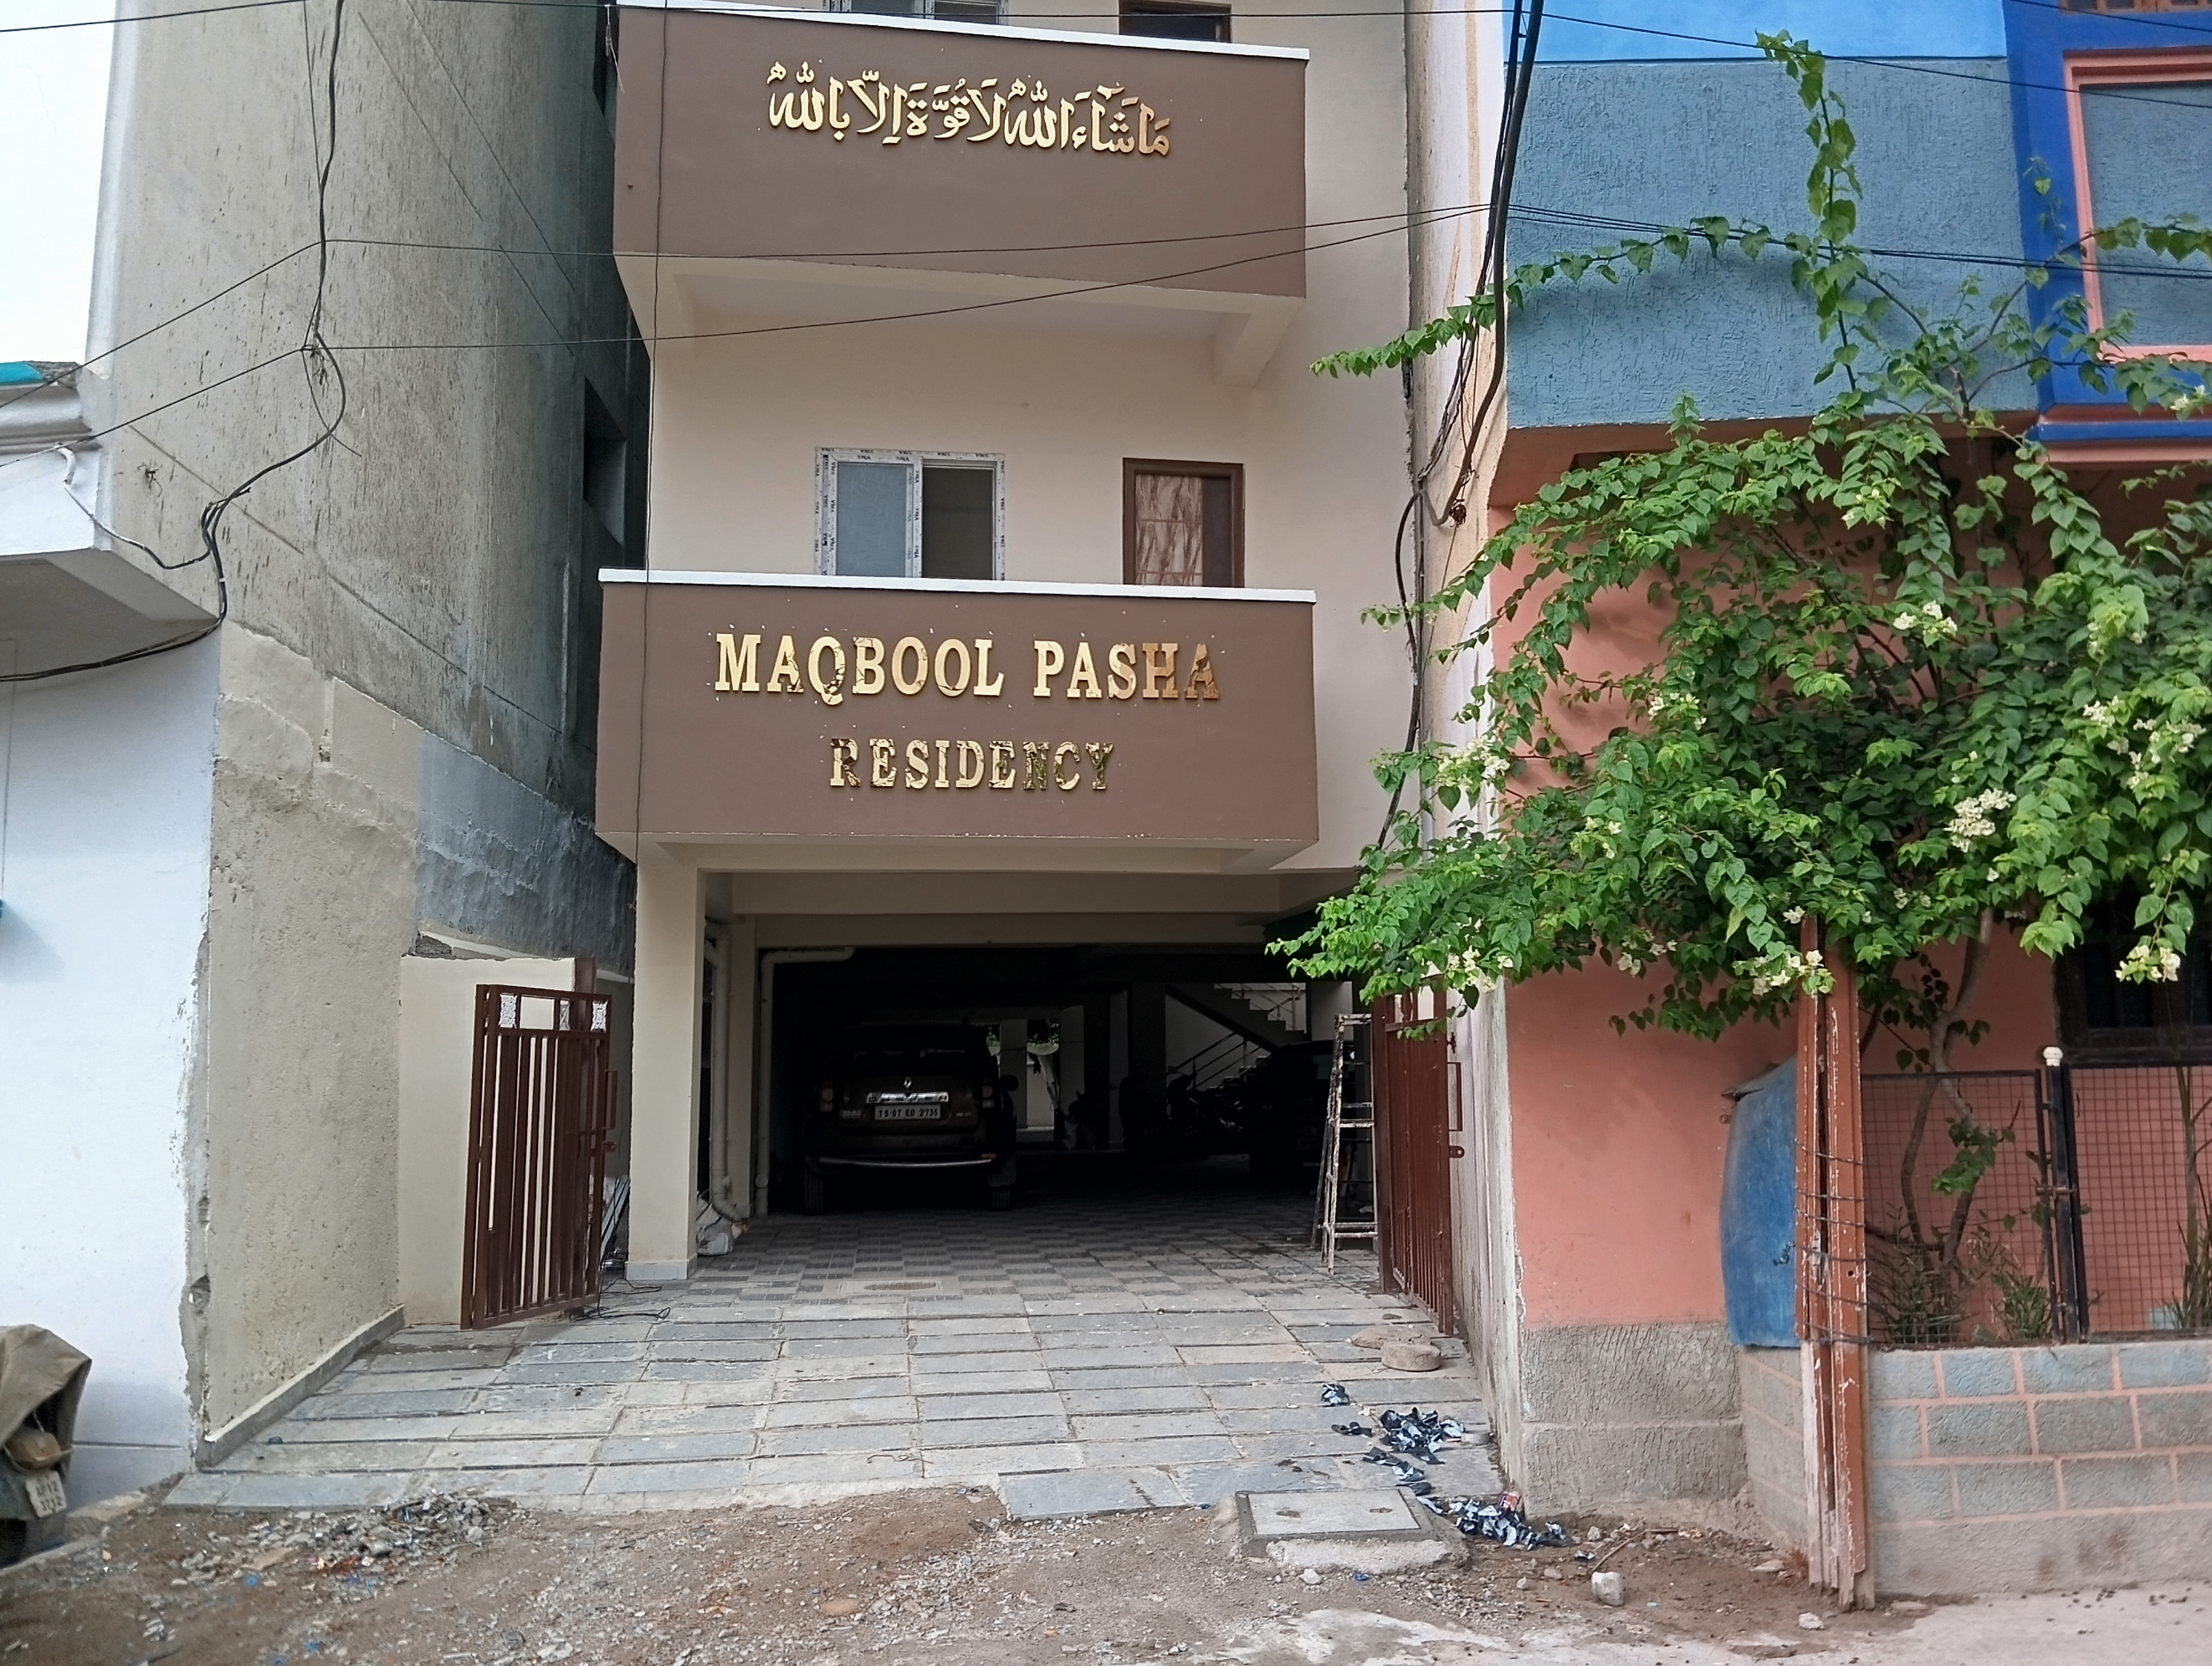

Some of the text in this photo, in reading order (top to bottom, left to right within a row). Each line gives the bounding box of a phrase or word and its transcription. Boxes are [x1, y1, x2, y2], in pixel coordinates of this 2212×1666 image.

[714, 632, 1221, 706] MAQBOOL PASHA
[829, 737, 1114, 791] RESIDENCY
